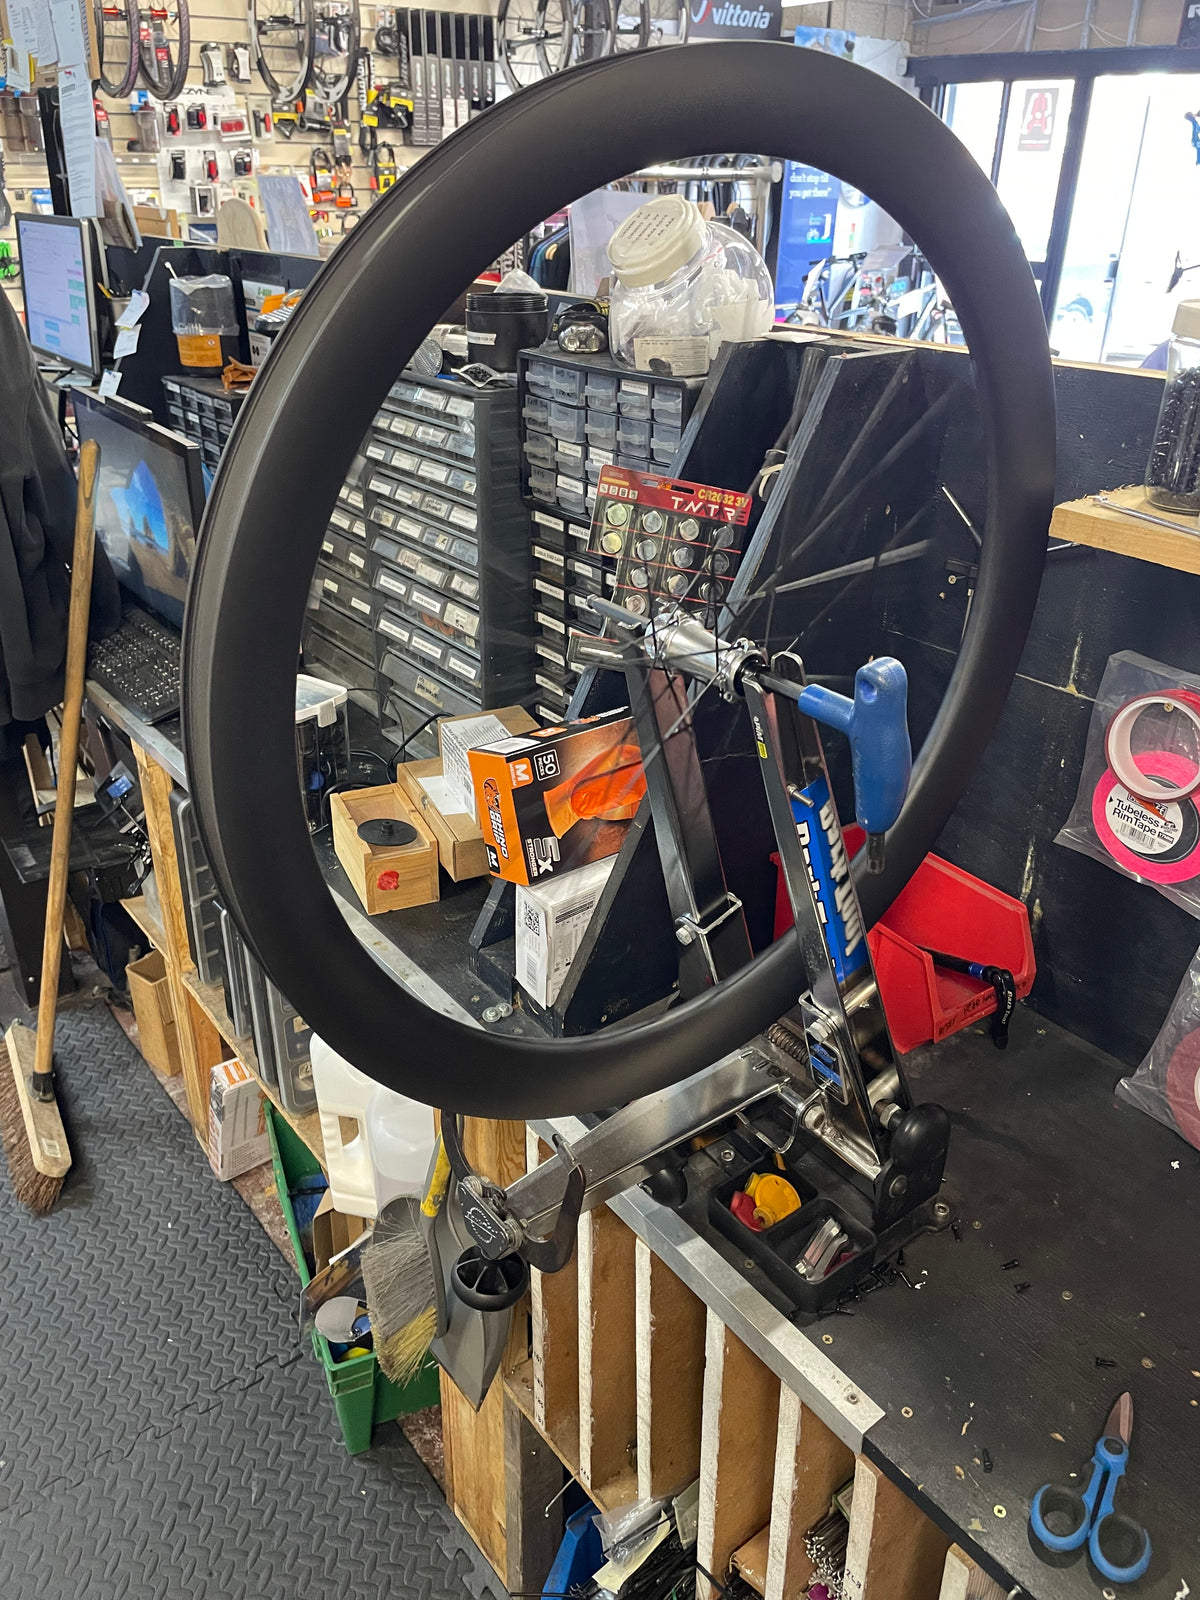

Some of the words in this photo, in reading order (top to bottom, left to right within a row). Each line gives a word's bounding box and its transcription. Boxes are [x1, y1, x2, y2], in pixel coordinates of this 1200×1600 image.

[712, 2, 771, 29] vittoria
[698, 488, 735, 506] CR2032
[734, 495, 750, 508] 3V
[514, 763, 530, 782] M
[542, 754, 556, 775] 50
[489, 809, 501, 845] GRIP
[1116, 798, 1160, 828] Tubeless
[495, 812, 508, 860] RHINO
[525, 838, 539, 878] STRONGER
